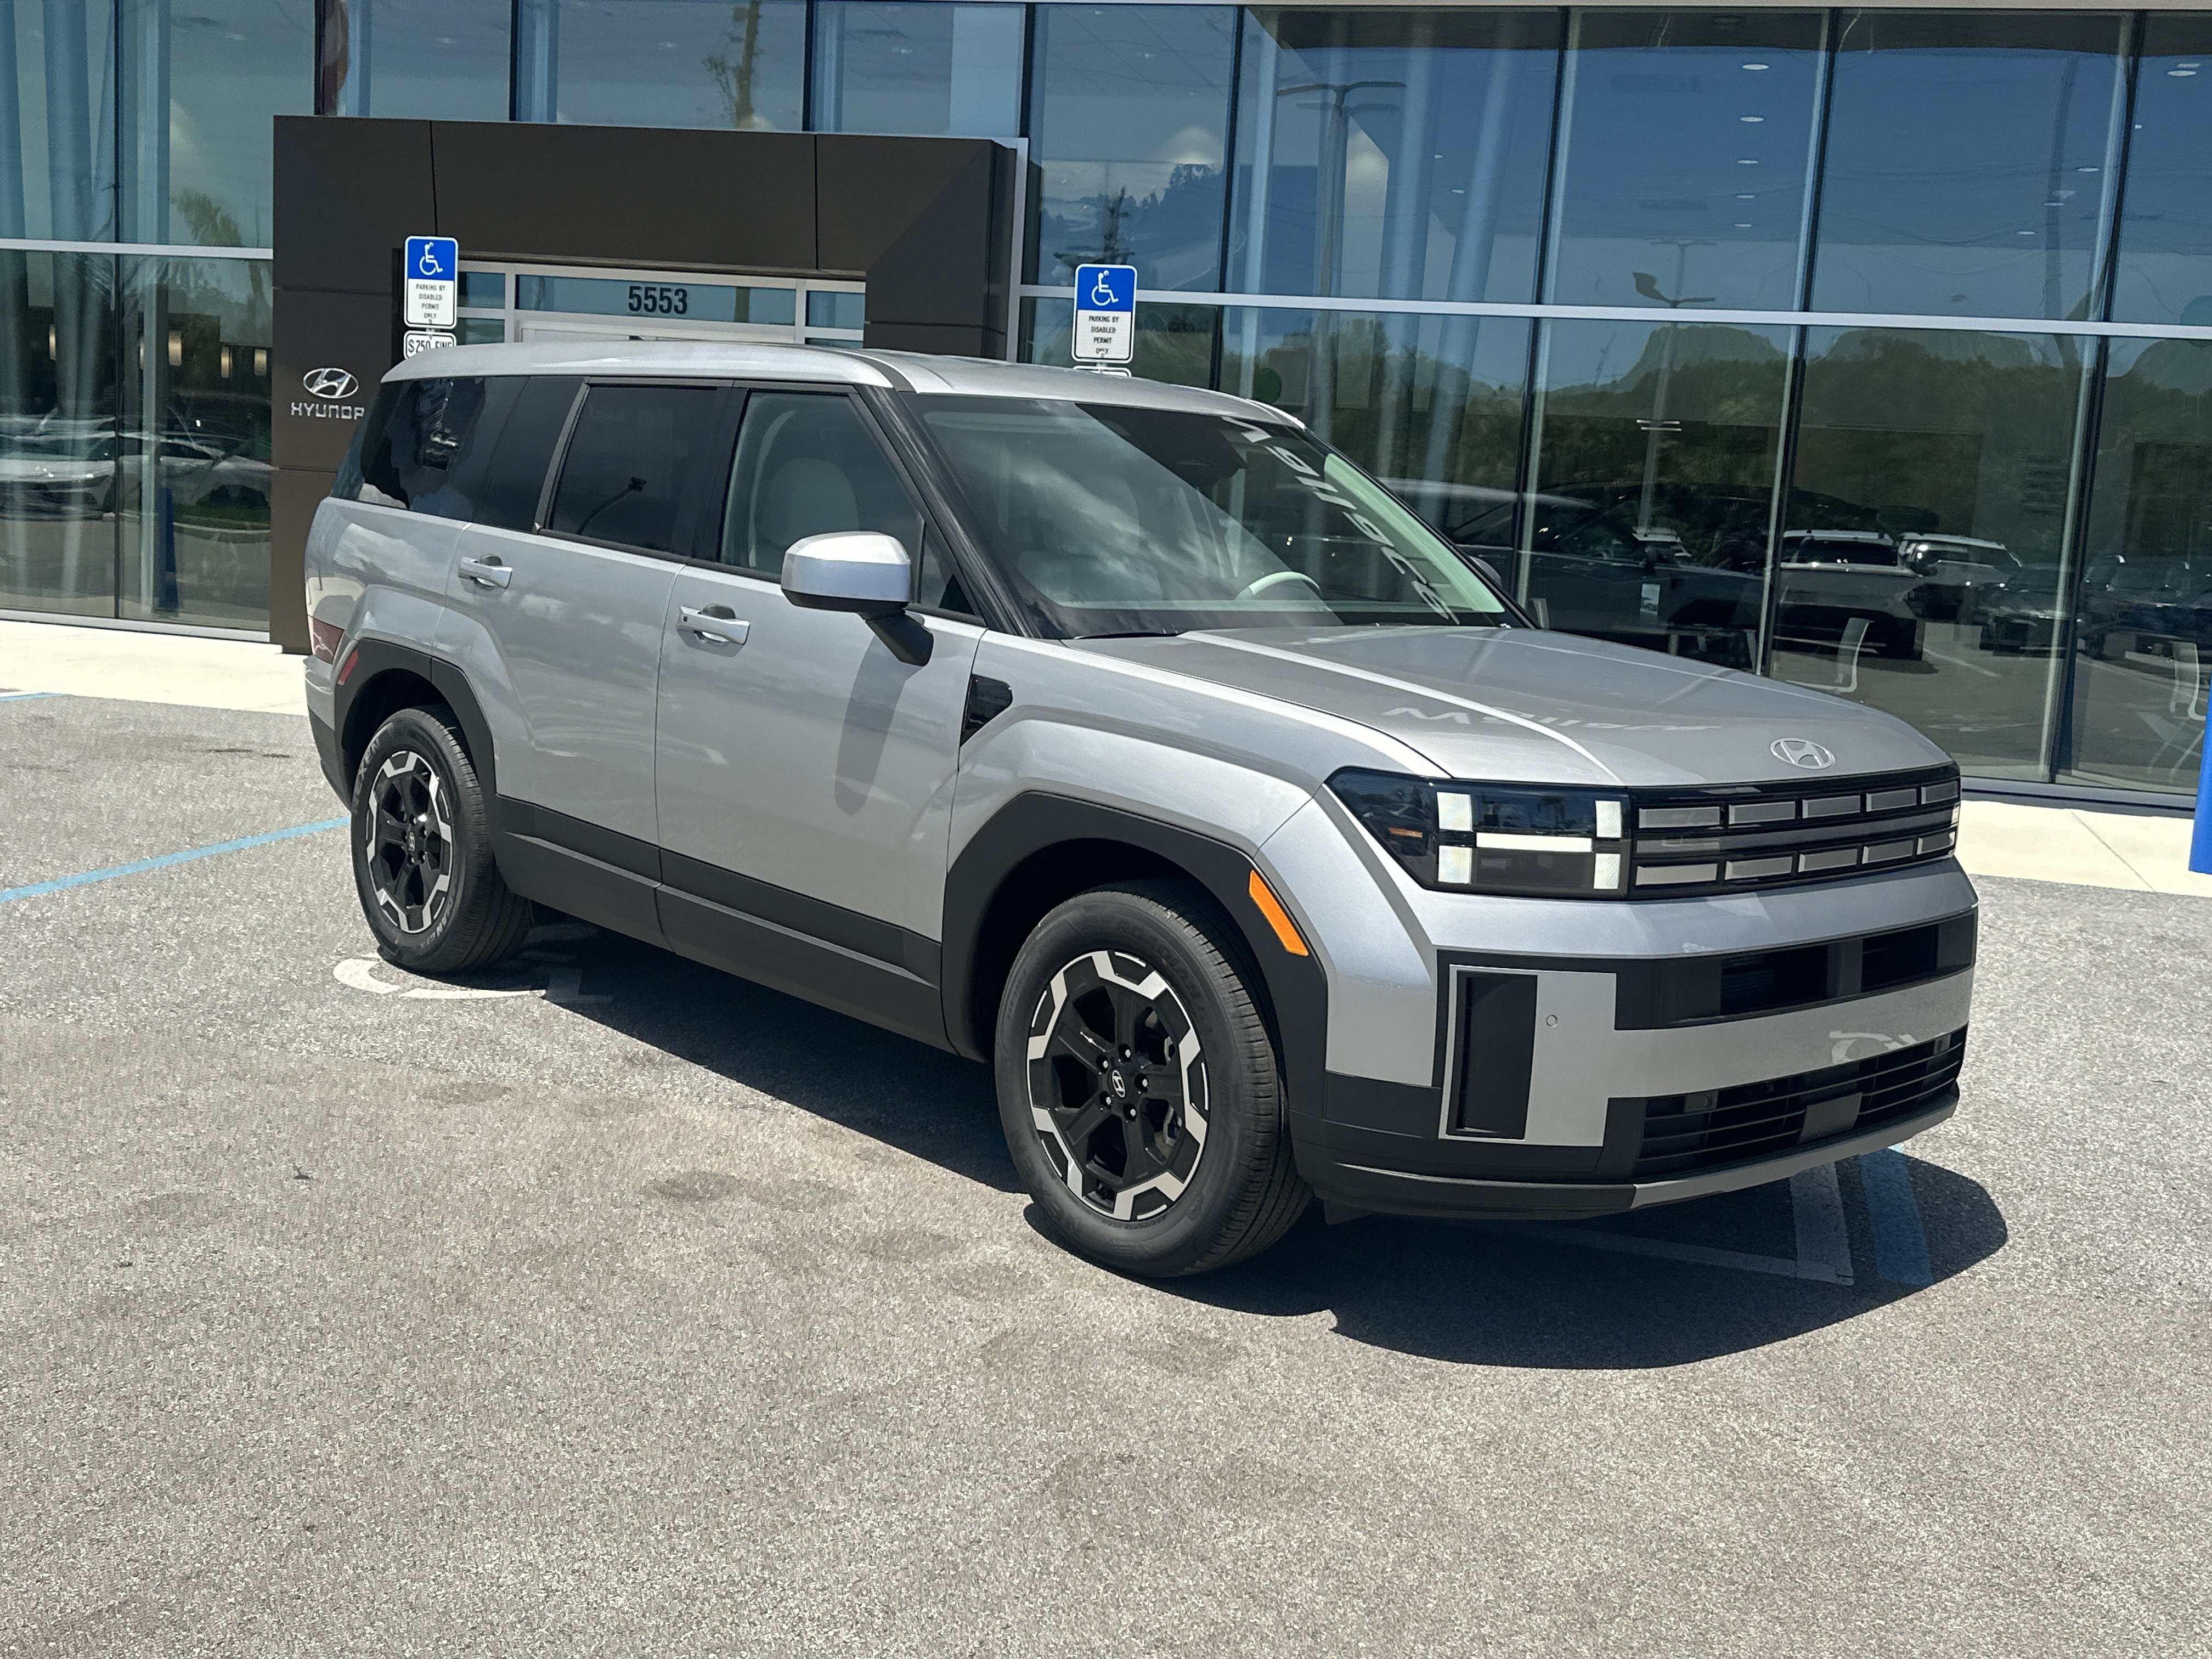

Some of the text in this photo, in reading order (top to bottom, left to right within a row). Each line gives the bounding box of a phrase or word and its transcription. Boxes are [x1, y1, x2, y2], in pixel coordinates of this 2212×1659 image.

[628, 286, 687, 314] 5553
[408, 339, 431, 353] $250
[291, 402, 364, 420] HYUNDA
